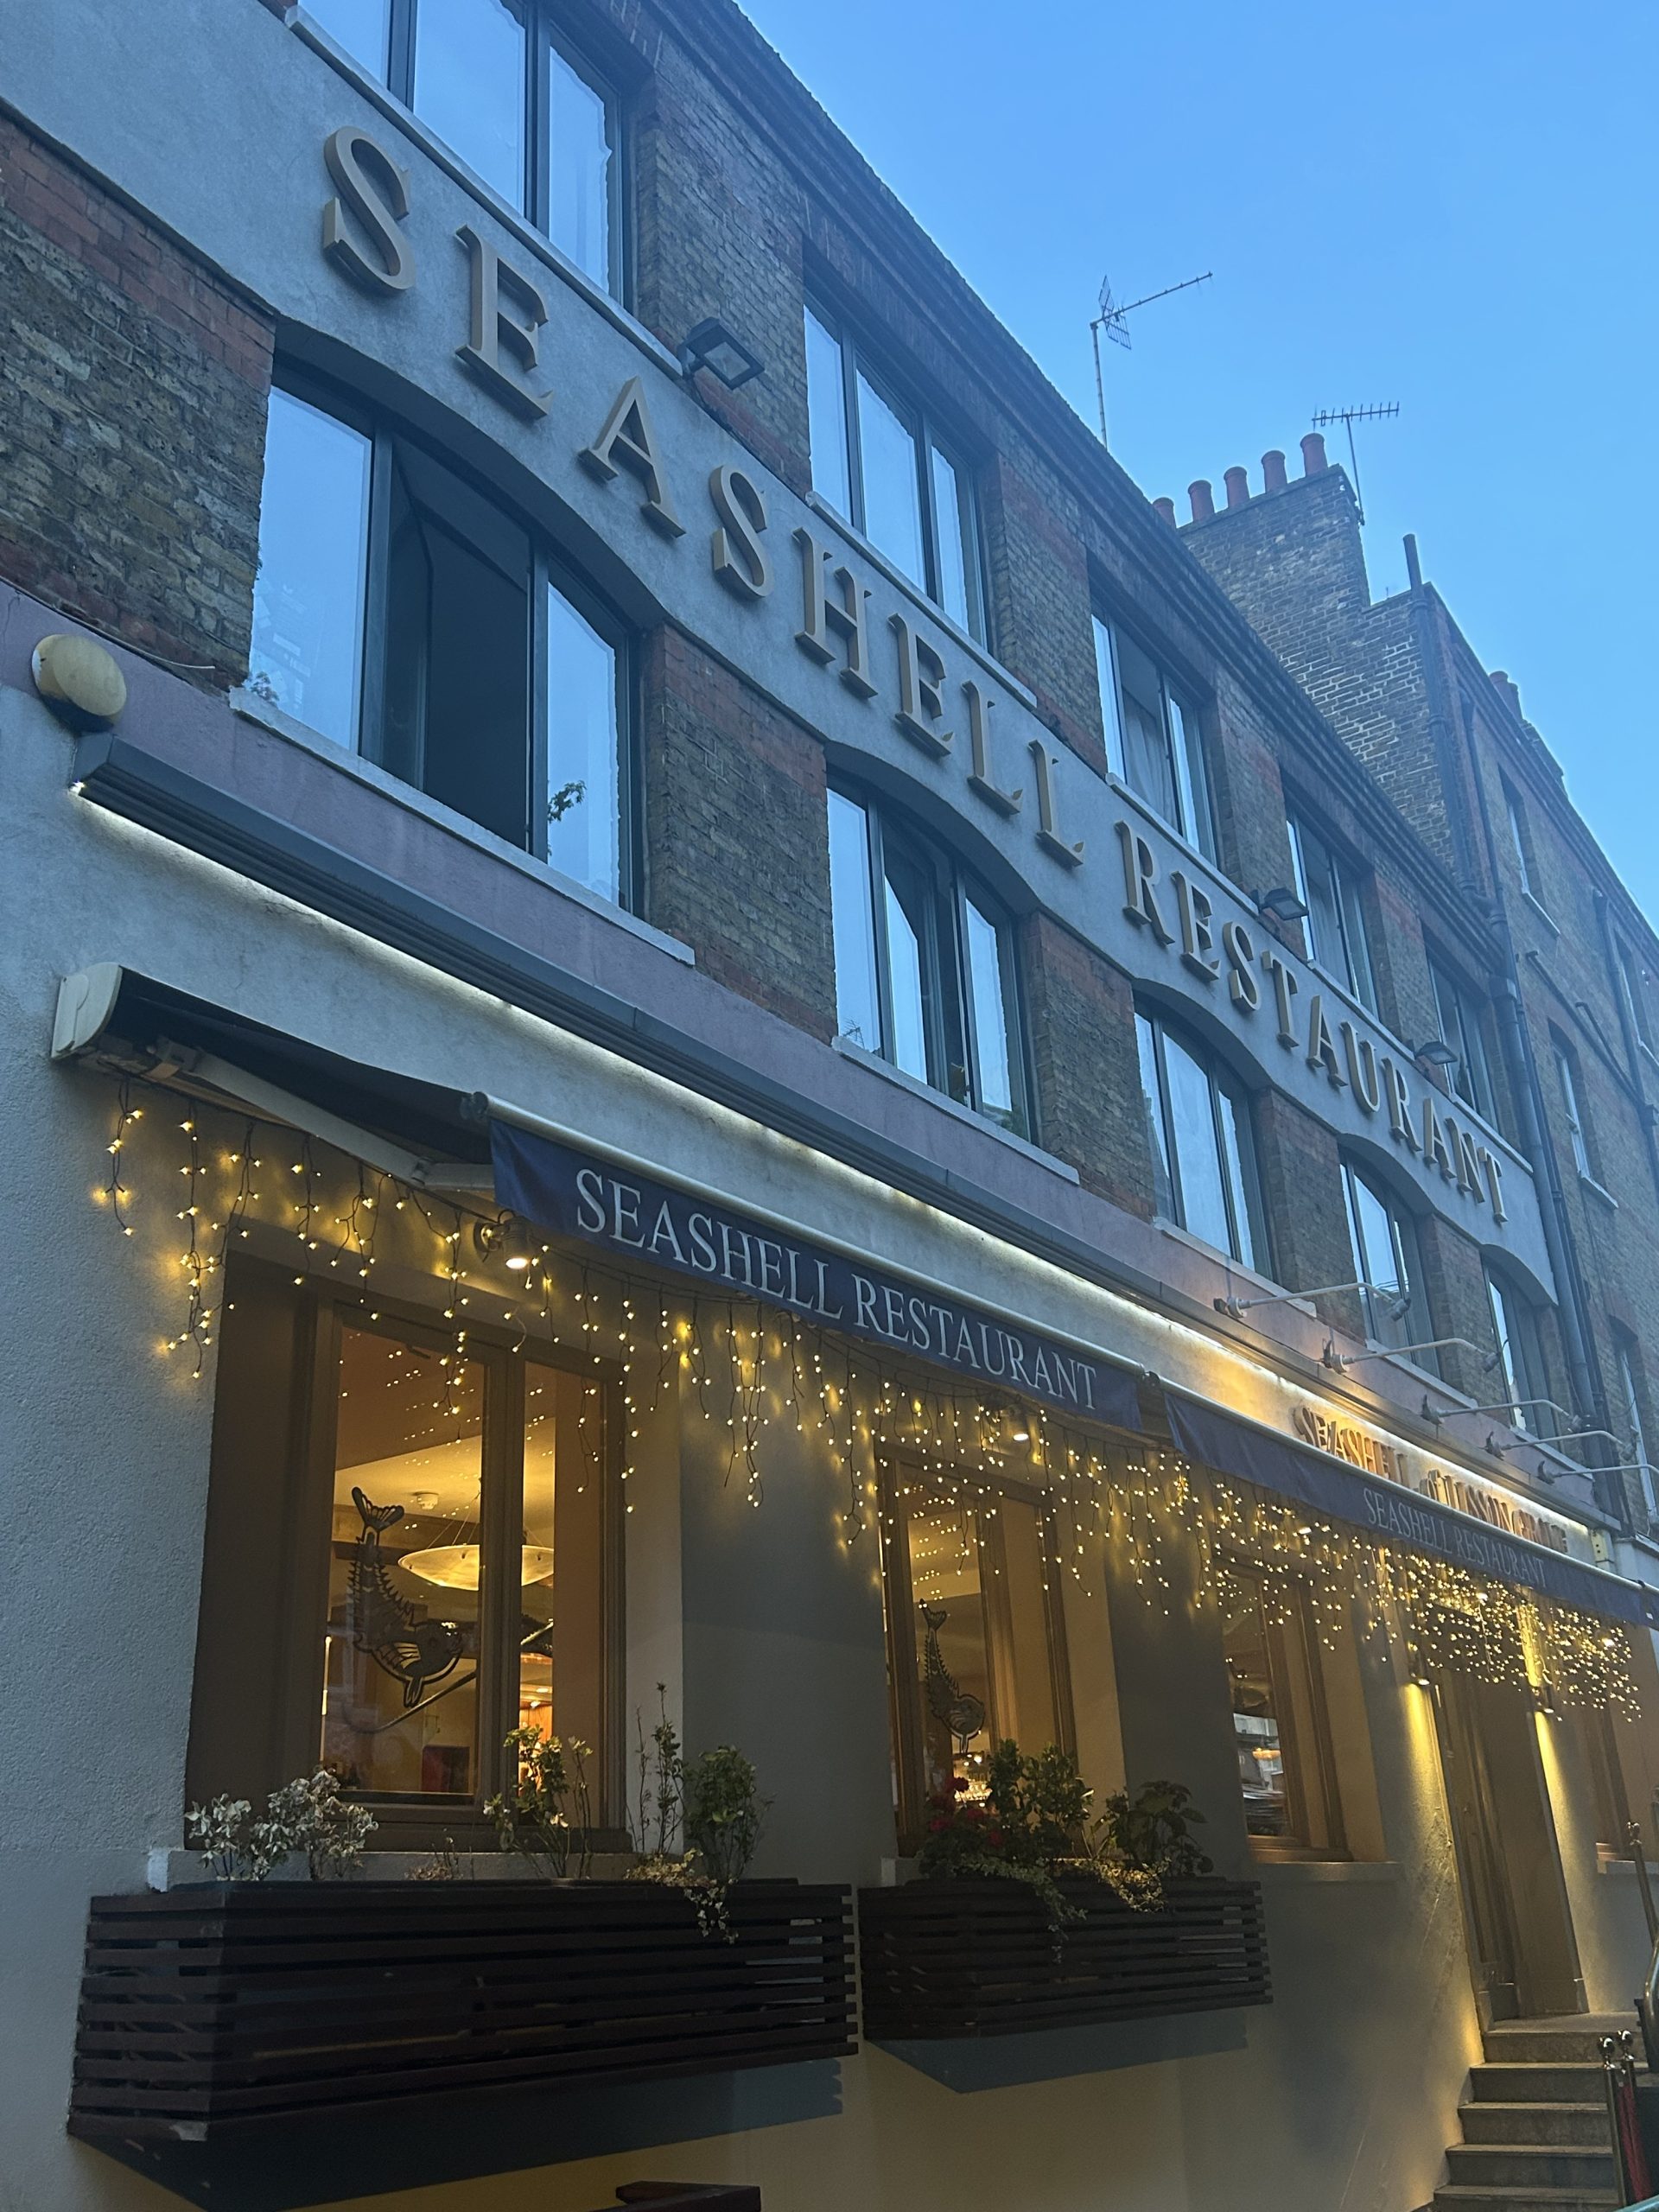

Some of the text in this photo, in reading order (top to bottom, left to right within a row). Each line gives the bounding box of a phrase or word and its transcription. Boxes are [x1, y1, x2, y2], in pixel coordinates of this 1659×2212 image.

[323, 125, 1508, 1224] SEASHELL RESTAURANT
[576, 1167, 1096, 1411] SEASHELL RESTAURANT
[1363, 1487, 1547, 1588] SEASHELL RESTAURANT
